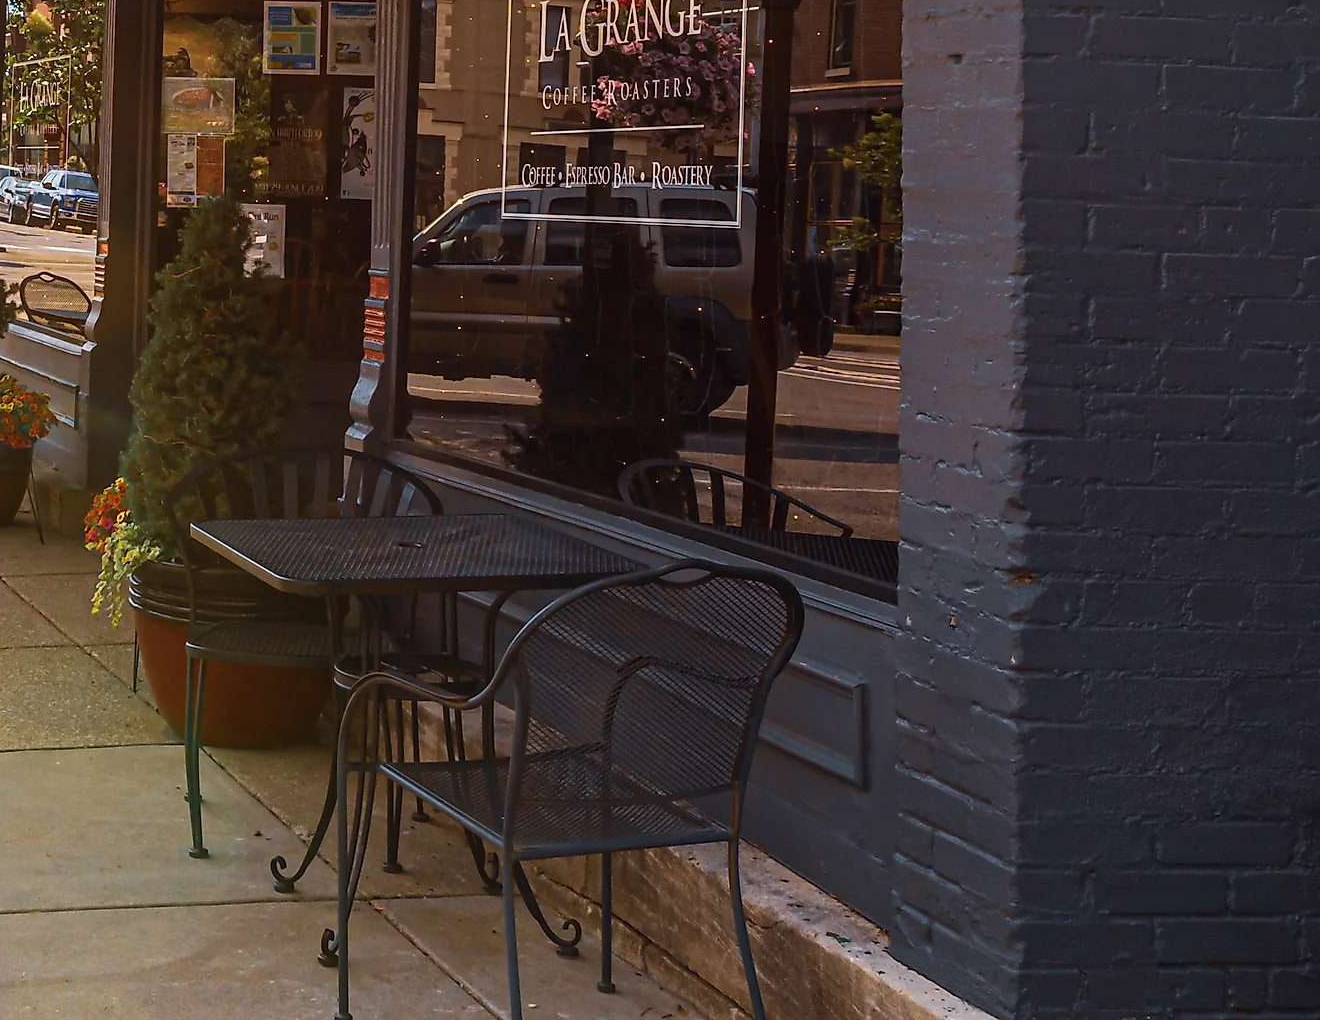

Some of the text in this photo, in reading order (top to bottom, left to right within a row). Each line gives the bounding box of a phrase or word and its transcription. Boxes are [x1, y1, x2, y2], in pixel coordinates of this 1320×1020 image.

[538, 0, 571, 63] LA
[542, 76, 692, 110] COFFEE ROASTERS
[521, 161, 714, 190] COFFEE ESPRESSO BAR ROASTERY
